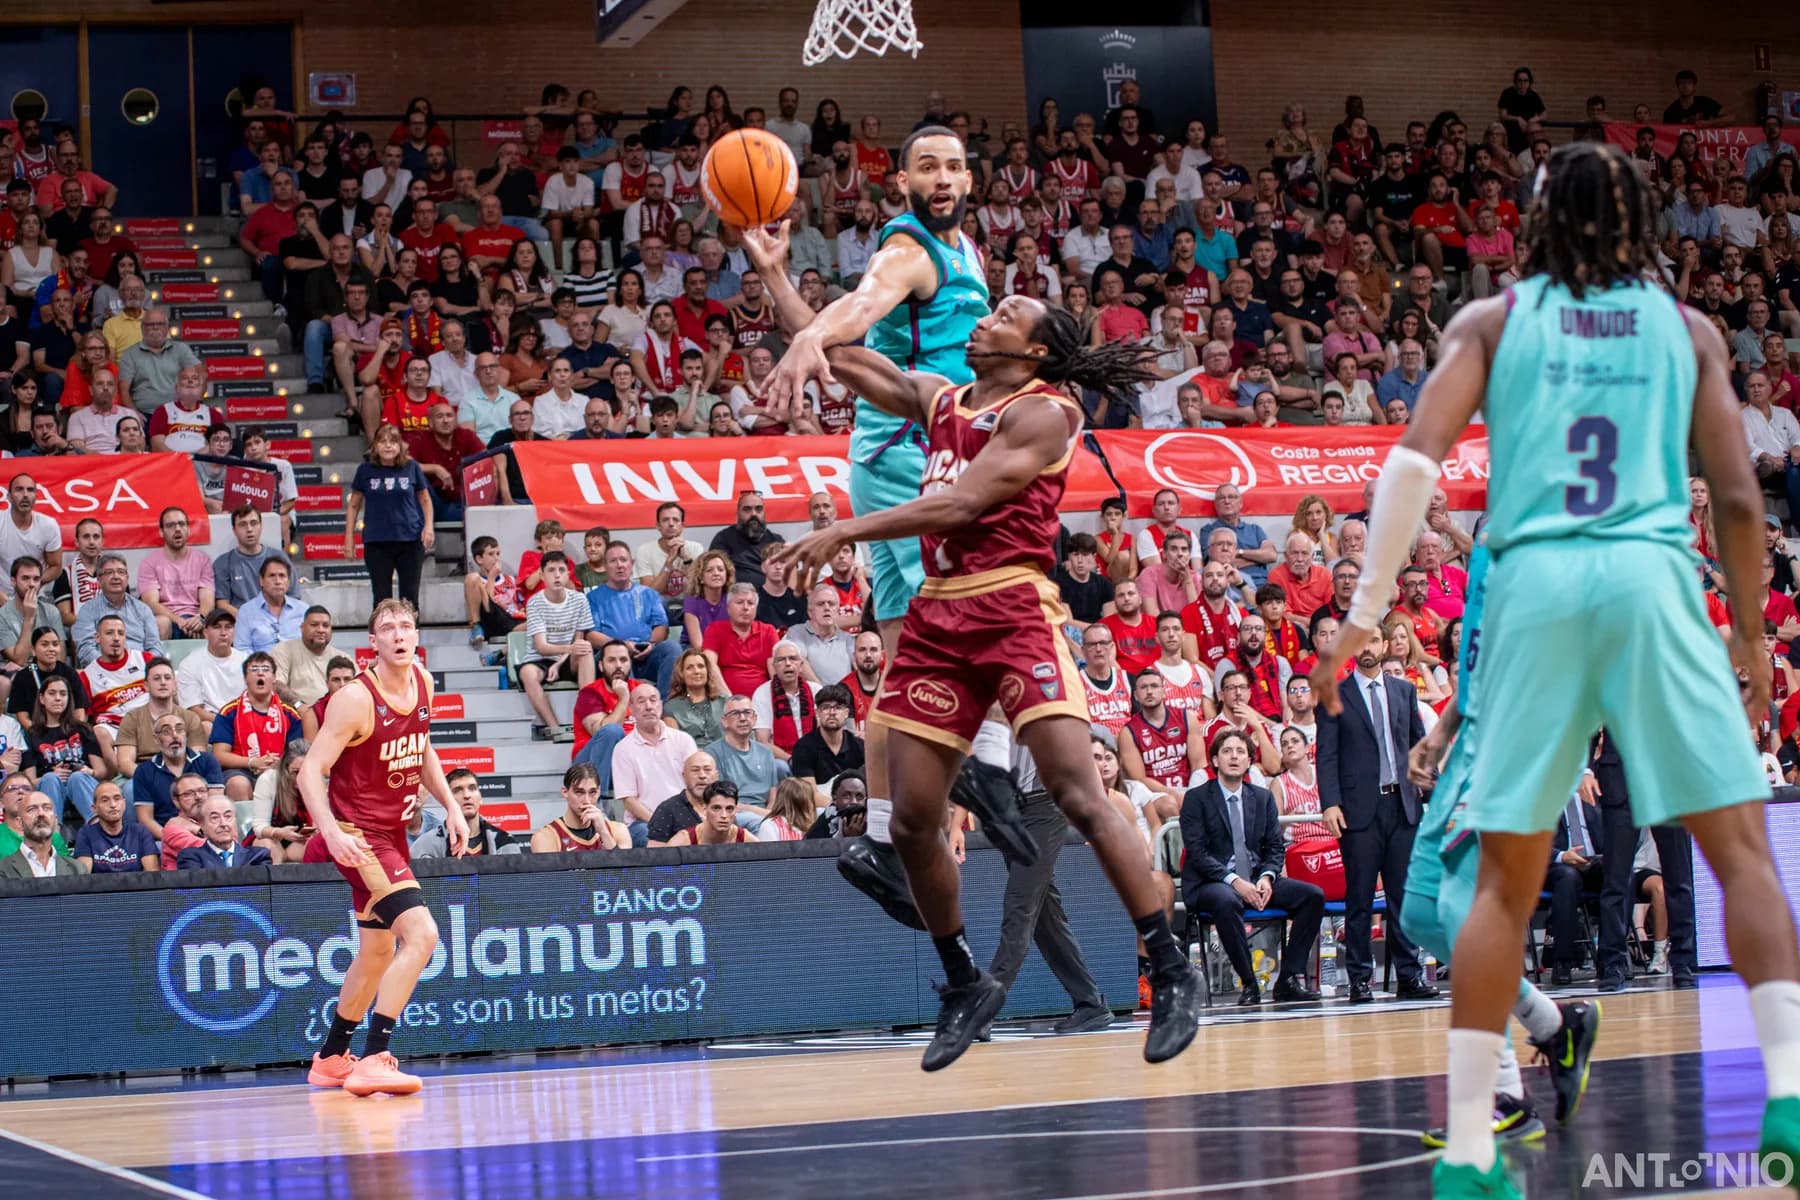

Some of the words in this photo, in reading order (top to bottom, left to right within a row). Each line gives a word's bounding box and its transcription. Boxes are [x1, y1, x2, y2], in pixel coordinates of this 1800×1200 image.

[1560, 307, 1638, 339] UMUDE
[738, 330, 767, 344] UCA
[400, 416, 429, 426] UCA
[1271, 446, 1320, 459] Costa
[1278, 460, 1384, 486] REGIÓ
[1440, 459, 1464, 480] E
[1565, 416, 1619, 517] 3
[231, 483, 268, 499] MÓDULO
[911, 688, 953, 711] Juver
[1089, 700, 1129, 716] UCAM
[1142, 745, 1187, 765] UCAM
[400, 794, 417, 821] 2
[592, 886, 702, 915] BANCO
[452, 998, 513, 1025] son
[524, 989, 575, 1021] tus
[586, 976, 706, 1017] metas?
